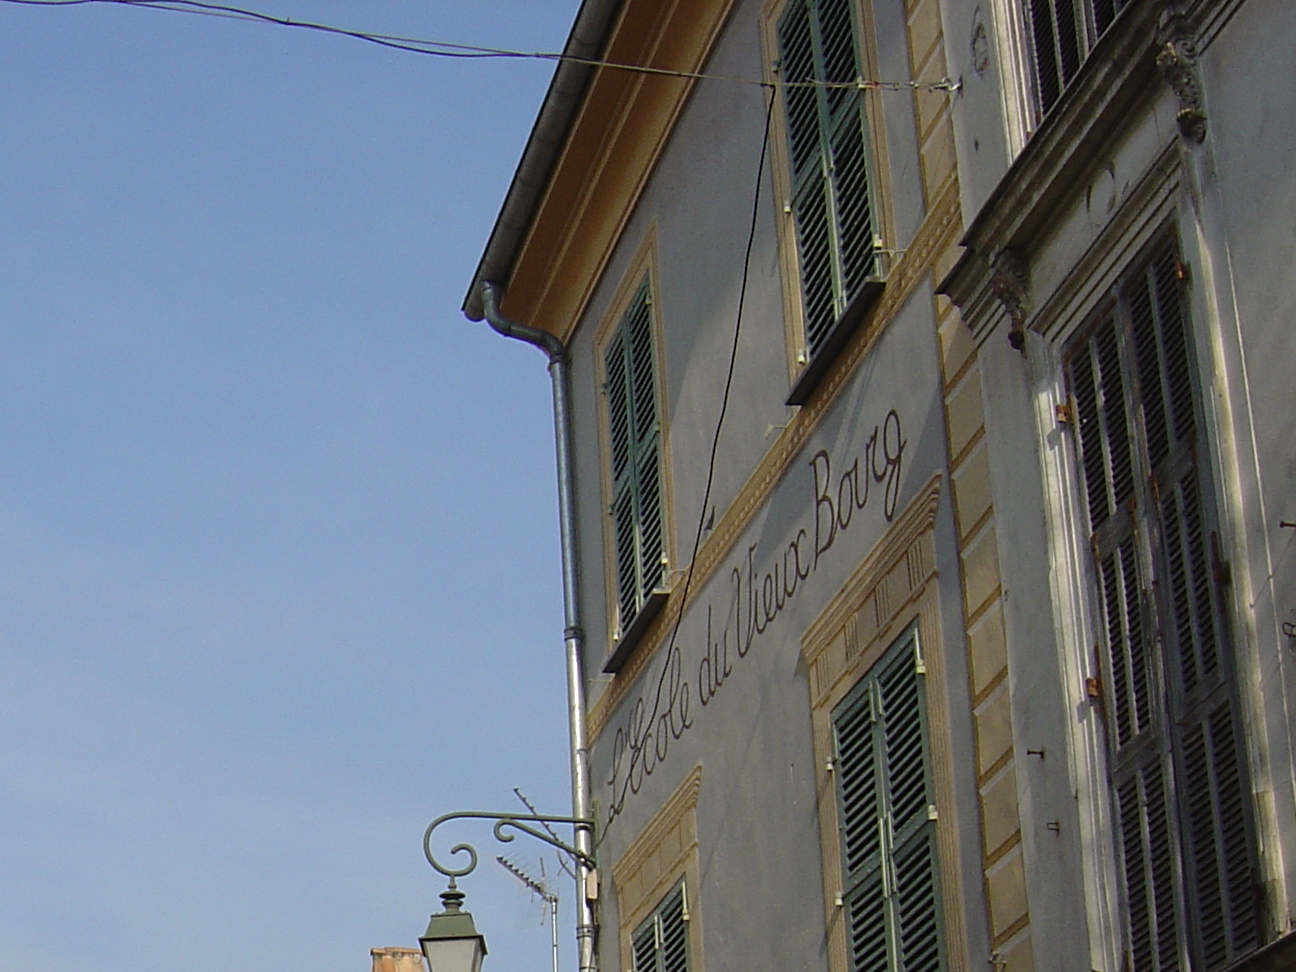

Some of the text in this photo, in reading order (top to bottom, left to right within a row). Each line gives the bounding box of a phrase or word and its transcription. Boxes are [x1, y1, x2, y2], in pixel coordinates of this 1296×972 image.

[699, 605, 732, 706] du
[731, 529, 811, 657] Vieux
[809, 408, 908, 570] Bourg
